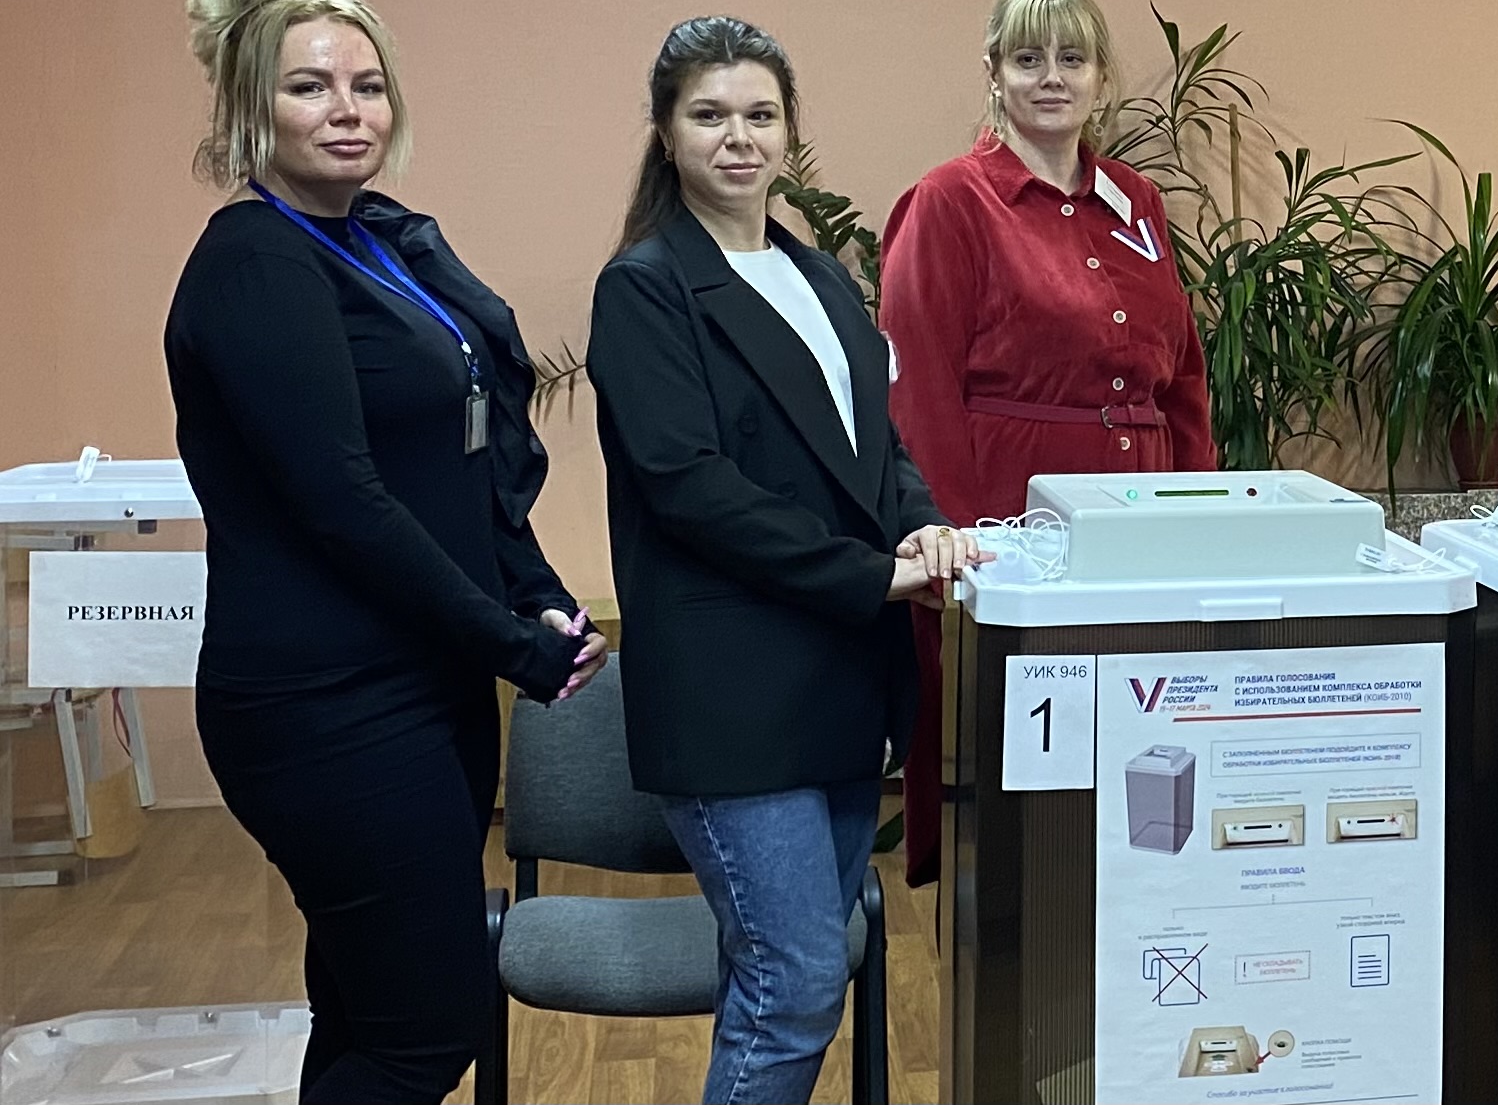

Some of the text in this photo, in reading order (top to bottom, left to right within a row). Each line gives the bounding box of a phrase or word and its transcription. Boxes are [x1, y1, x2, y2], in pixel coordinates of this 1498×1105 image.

[67, 605, 195, 621] РЕЗЕРВНАЯ
[1024, 665, 1088, 679] УИК 946
[1234, 673, 1336, 684] ПРАВИЛА ГОЛОСОВАНИЯ
[1170, 676, 1208, 684] ВЫБОРЫ
[1166, 685, 1219, 694] ПРЕЗИДЕНТА
[1234, 681, 1422, 695] С ИСПОЛЬЗОВАНИЕМ КОМПЛЕКСА ОБРАБОТКИ
[1162, 696, 1196, 704] РОССИИ
[1234, 697, 1306, 707] ИЗБИРАТЕЛЬНЫХ
[1308, 694, 1362, 704] БЮЛЛЕТЕНЕЙ
[1029, 697, 1052, 752] 1
